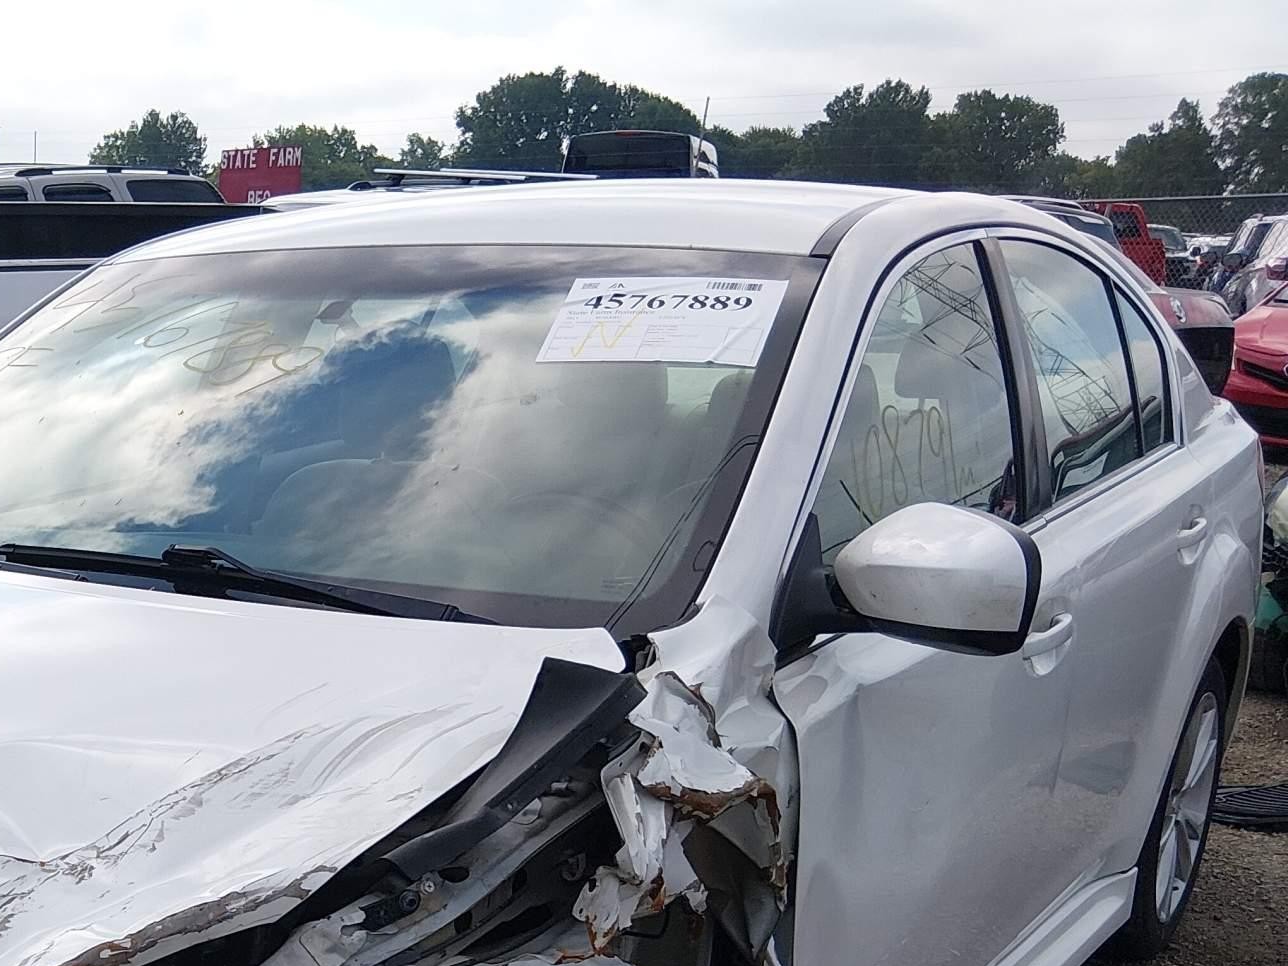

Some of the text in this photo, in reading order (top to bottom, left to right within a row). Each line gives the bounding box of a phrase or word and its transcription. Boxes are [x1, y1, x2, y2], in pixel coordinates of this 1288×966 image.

[220, 147, 303, 169] STATE FARM
[584, 293, 753, 311] 45767889
